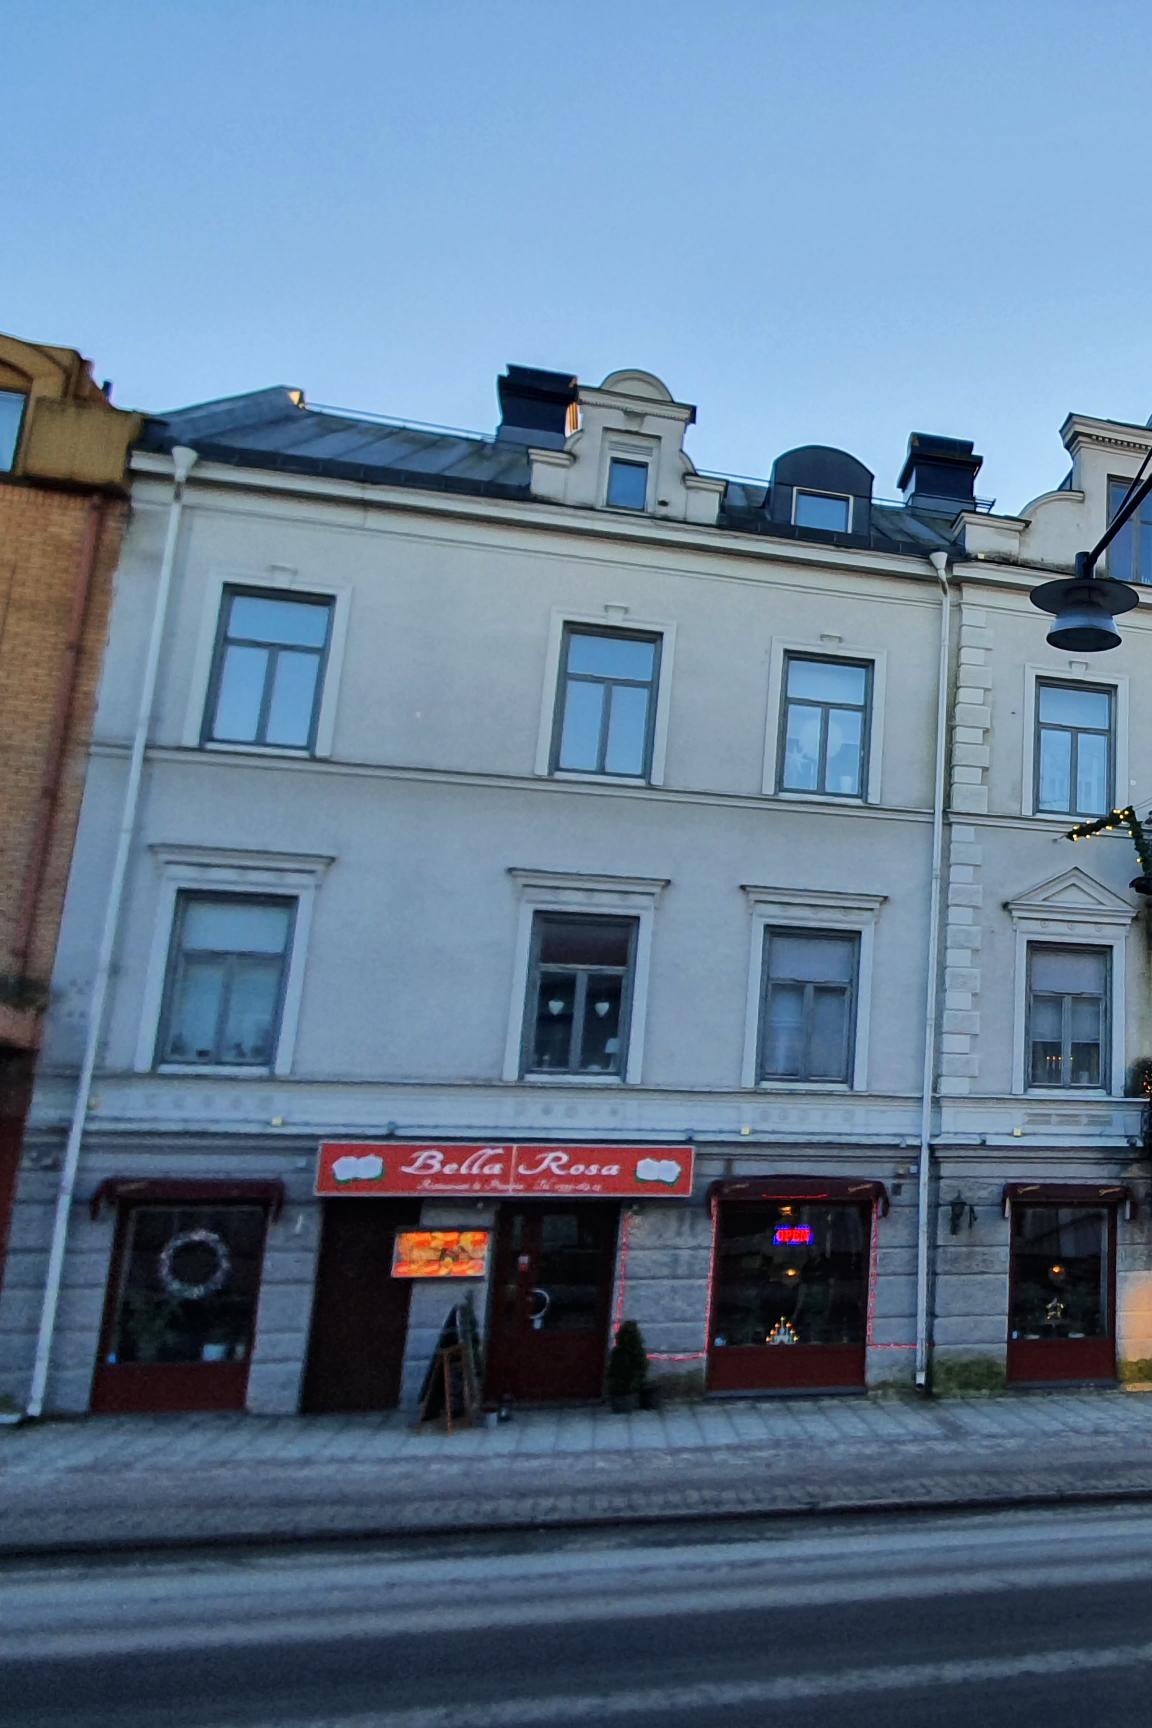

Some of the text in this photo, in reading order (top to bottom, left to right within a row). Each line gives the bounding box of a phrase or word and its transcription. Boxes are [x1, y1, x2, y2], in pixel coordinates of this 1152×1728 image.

[400, 1148, 620, 1176] Bella Rosa
[776, 1228, 812, 1242] OPEN
